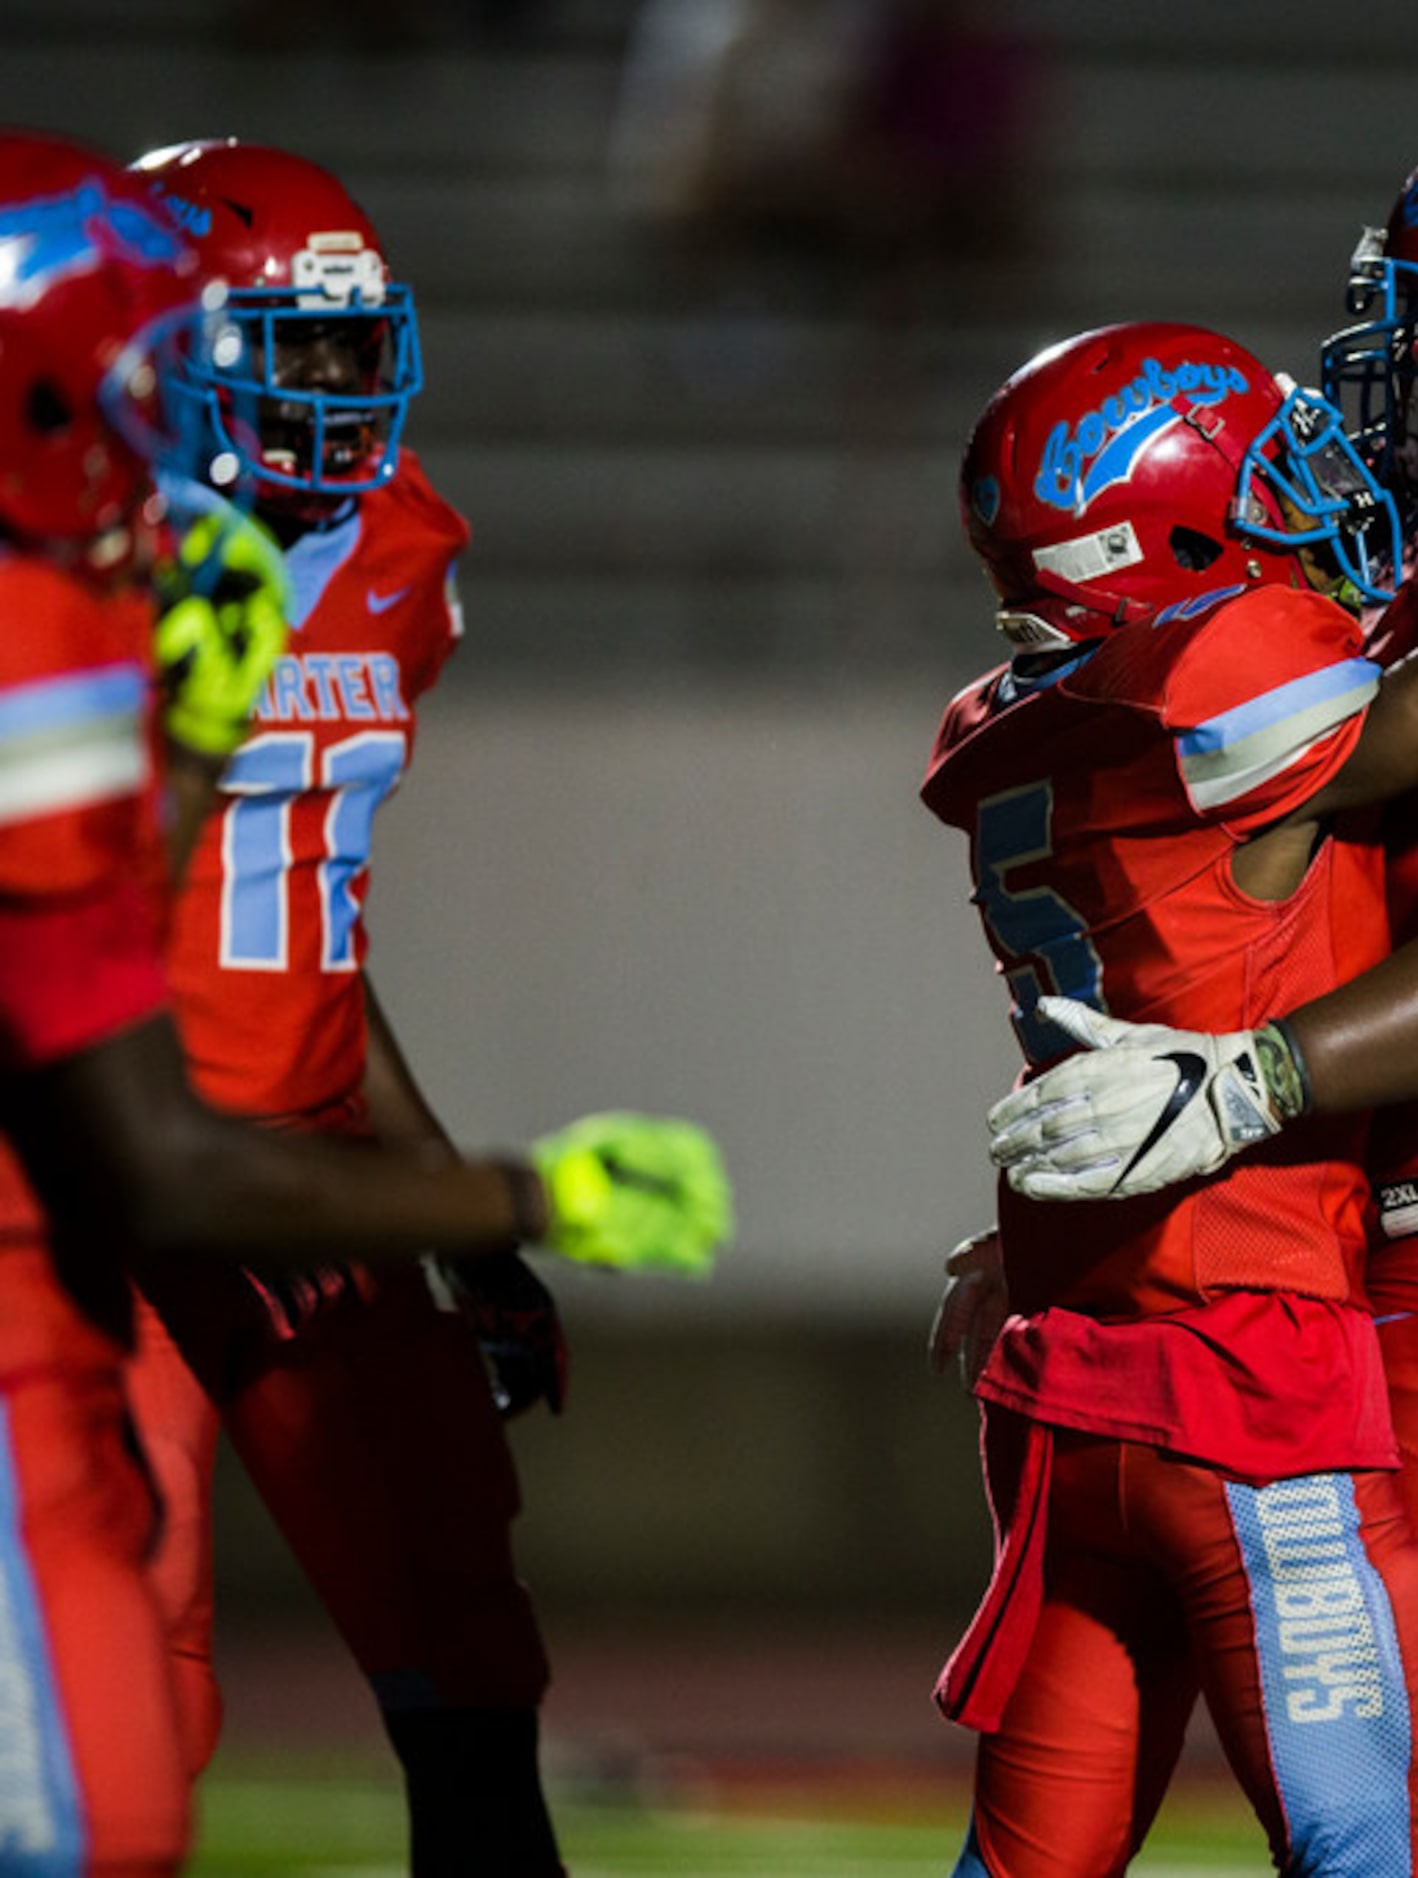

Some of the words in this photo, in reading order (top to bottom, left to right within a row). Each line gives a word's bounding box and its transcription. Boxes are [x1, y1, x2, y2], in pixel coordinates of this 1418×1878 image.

[1034, 357, 1250, 511] Cowboys
[252, 651, 411, 722] RTER
[217, 730, 408, 972] 11
[1256, 1472, 1385, 1724] OWBOYS
